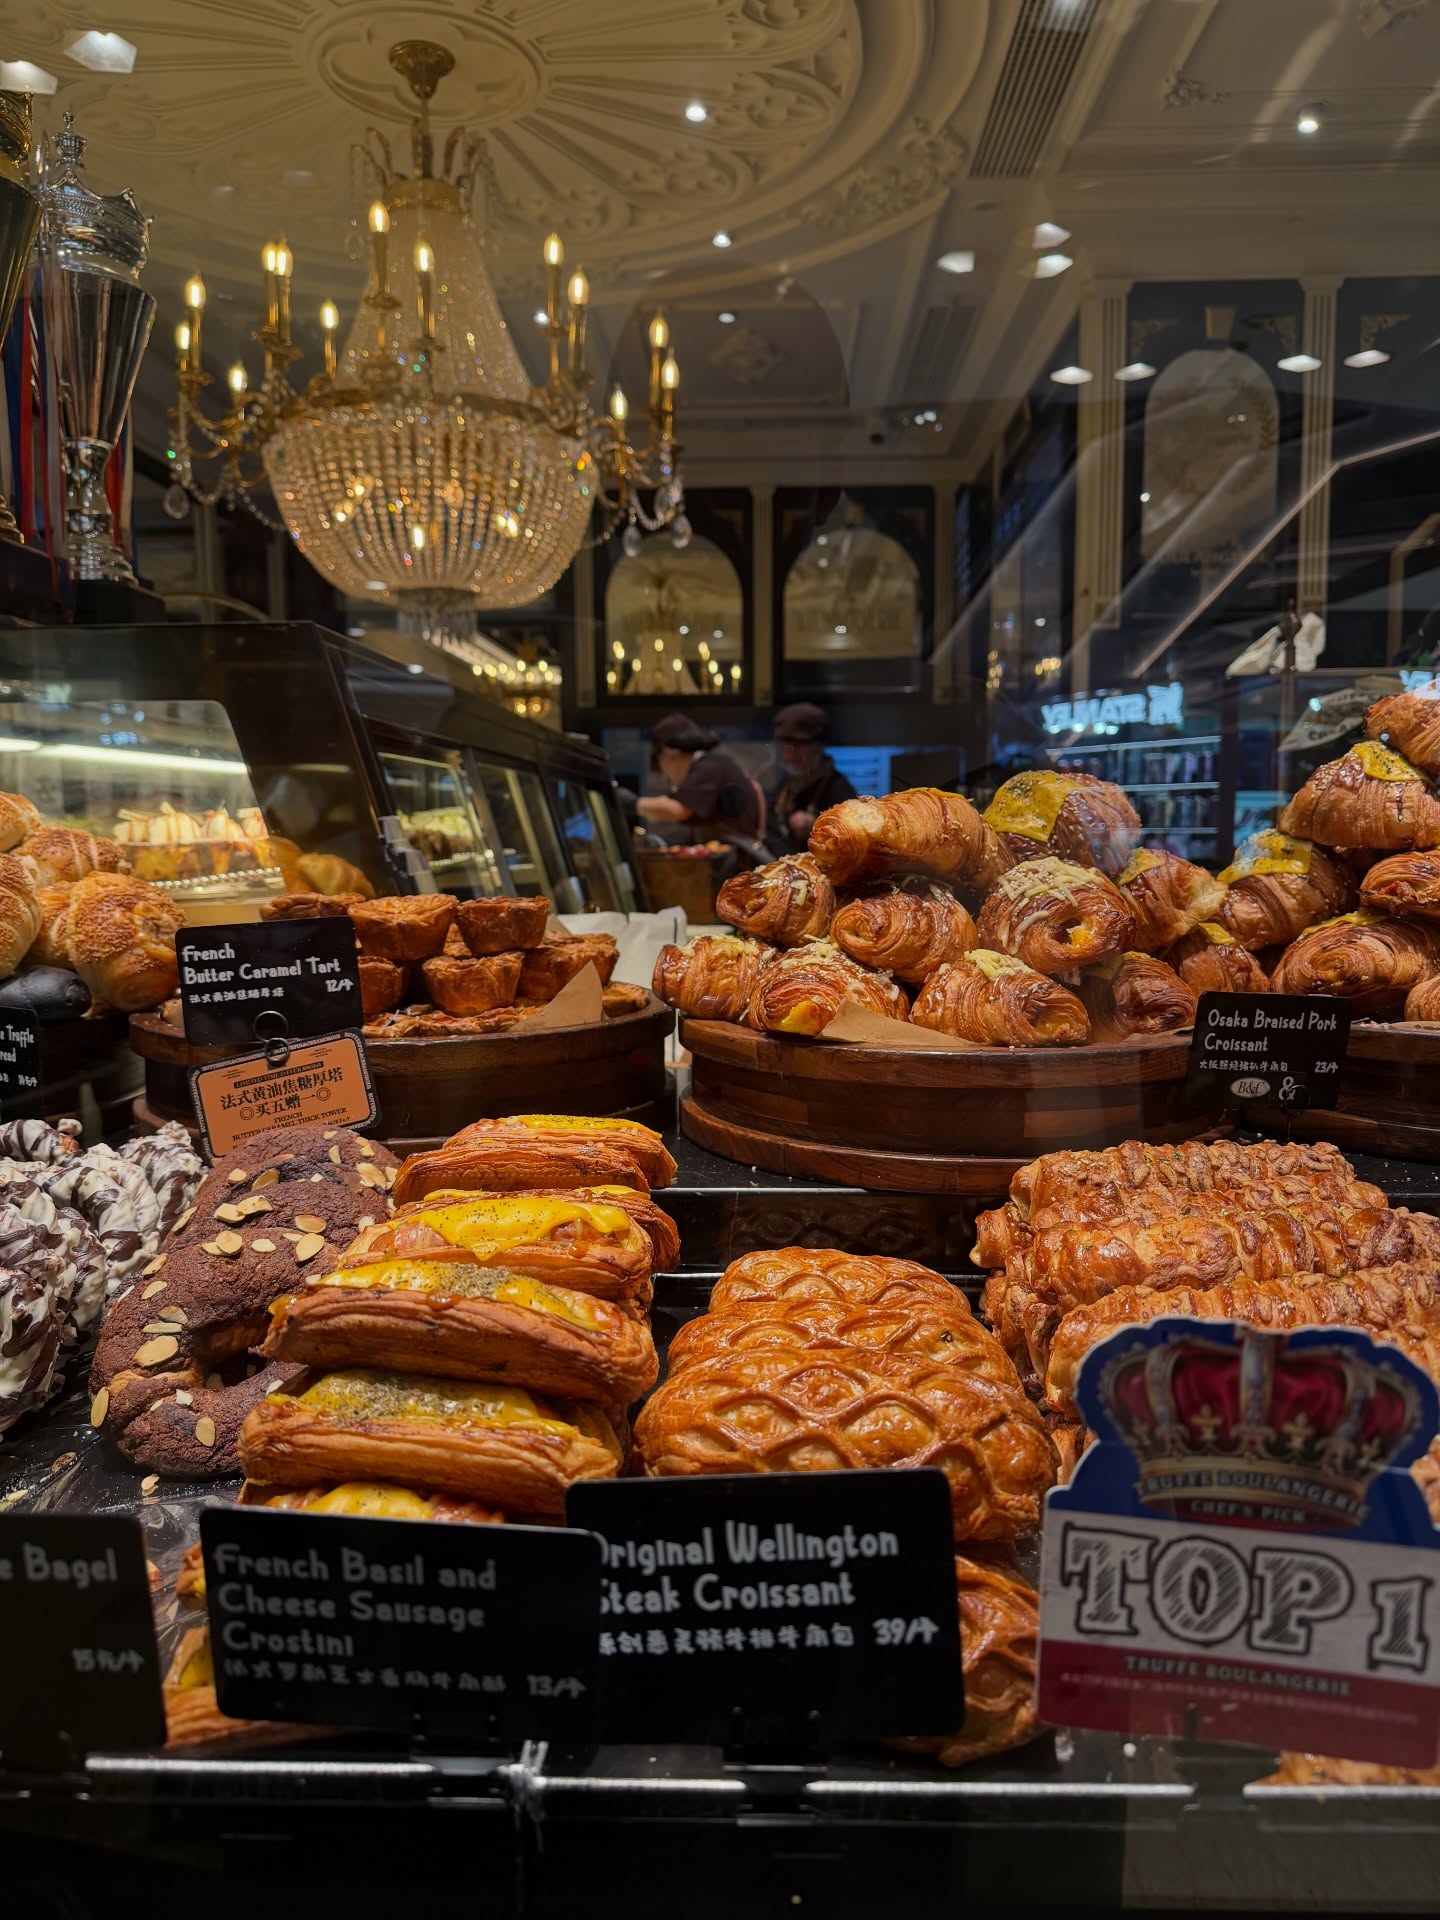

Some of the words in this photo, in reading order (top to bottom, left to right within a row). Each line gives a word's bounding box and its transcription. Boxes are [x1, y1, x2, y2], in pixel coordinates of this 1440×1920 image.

[182, 943, 236, 962] French
[184, 966, 235, 985] Butter
[239, 960, 302, 980] Caramel
[305, 956, 341, 974] Tart
[5, 1024, 35, 1048] Truffle
[1208, 1008, 1248, 1028] Osaka
[1254, 1008, 1305, 1030] Braised
[1307, 1010, 1337, 1031] Pork
[1204, 1032, 1269, 1052] Croissant
[220, 1067, 343, 1111] 法式黄油焦糖厚塔
[274, 1112, 303, 1124] FRENCH
[321, 1107, 347, 1118] TOWER
[725, 1519, 899, 1568] Wellington
[23, 1542, 118, 1590] Bagel
[213, 1542, 330, 1581] French
[341, 1546, 424, 1586] Basil
[439, 1558, 497, 1590] and
[218, 1581, 337, 1619] Cheese
[349, 1589, 486, 1632] Sausage
[694, 1571, 856, 1612] Croissant
[1061, 1522, 1354, 1656] TOP
[1367, 1575, 1435, 1675] 1
[222, 1619, 354, 1657] Crostini
[1125, 1654, 1200, 1678] TRUFFE
[1205, 1658, 1353, 1698] BOULANGERIE
